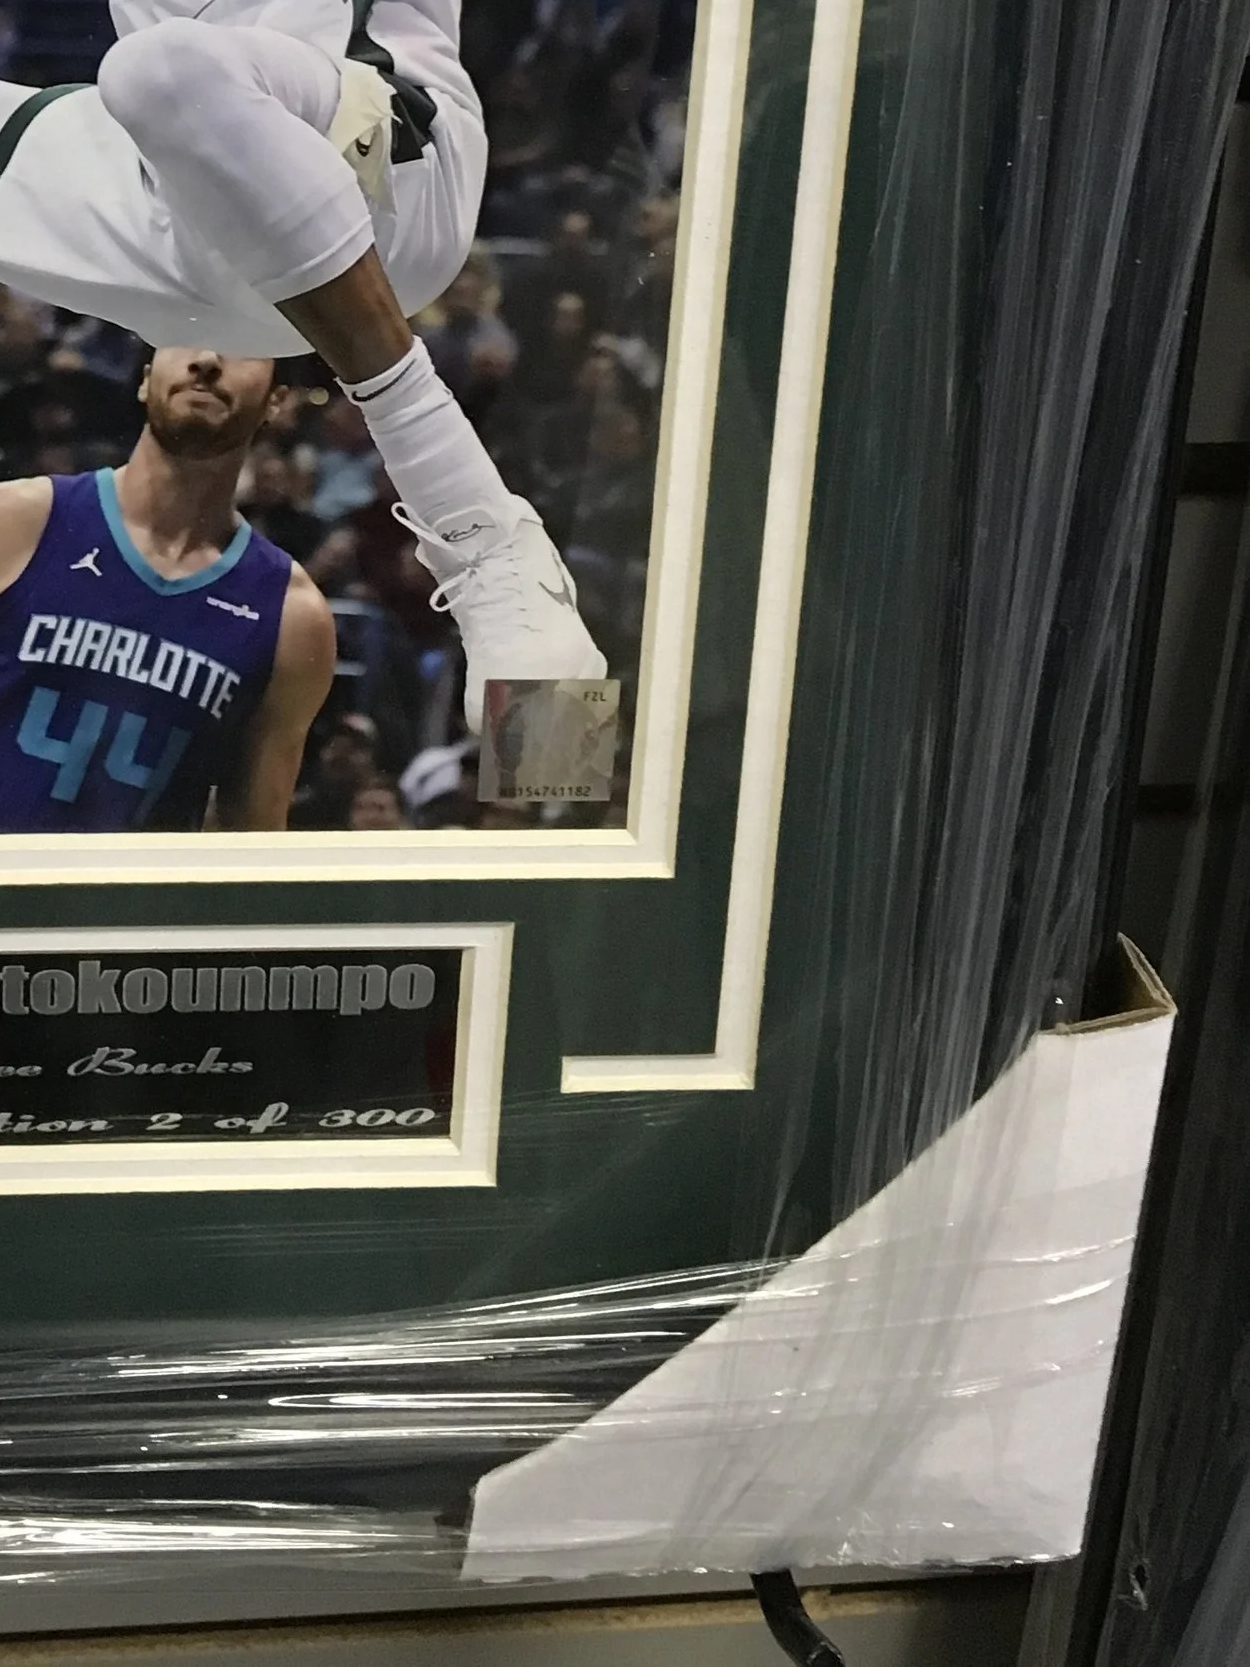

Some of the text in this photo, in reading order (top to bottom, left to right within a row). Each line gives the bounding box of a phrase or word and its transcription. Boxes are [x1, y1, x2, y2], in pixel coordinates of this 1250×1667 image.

[18, 613, 241, 721] CHARLOTTE
[583, 691, 607, 702] FZL
[16, 686, 192, 831] 44
[66, 1045, 254, 1078] Bucks
[144, 1111, 184, 1131] 2
[213, 1101, 291, 1134] of
[318, 1106, 438, 1128] 300
